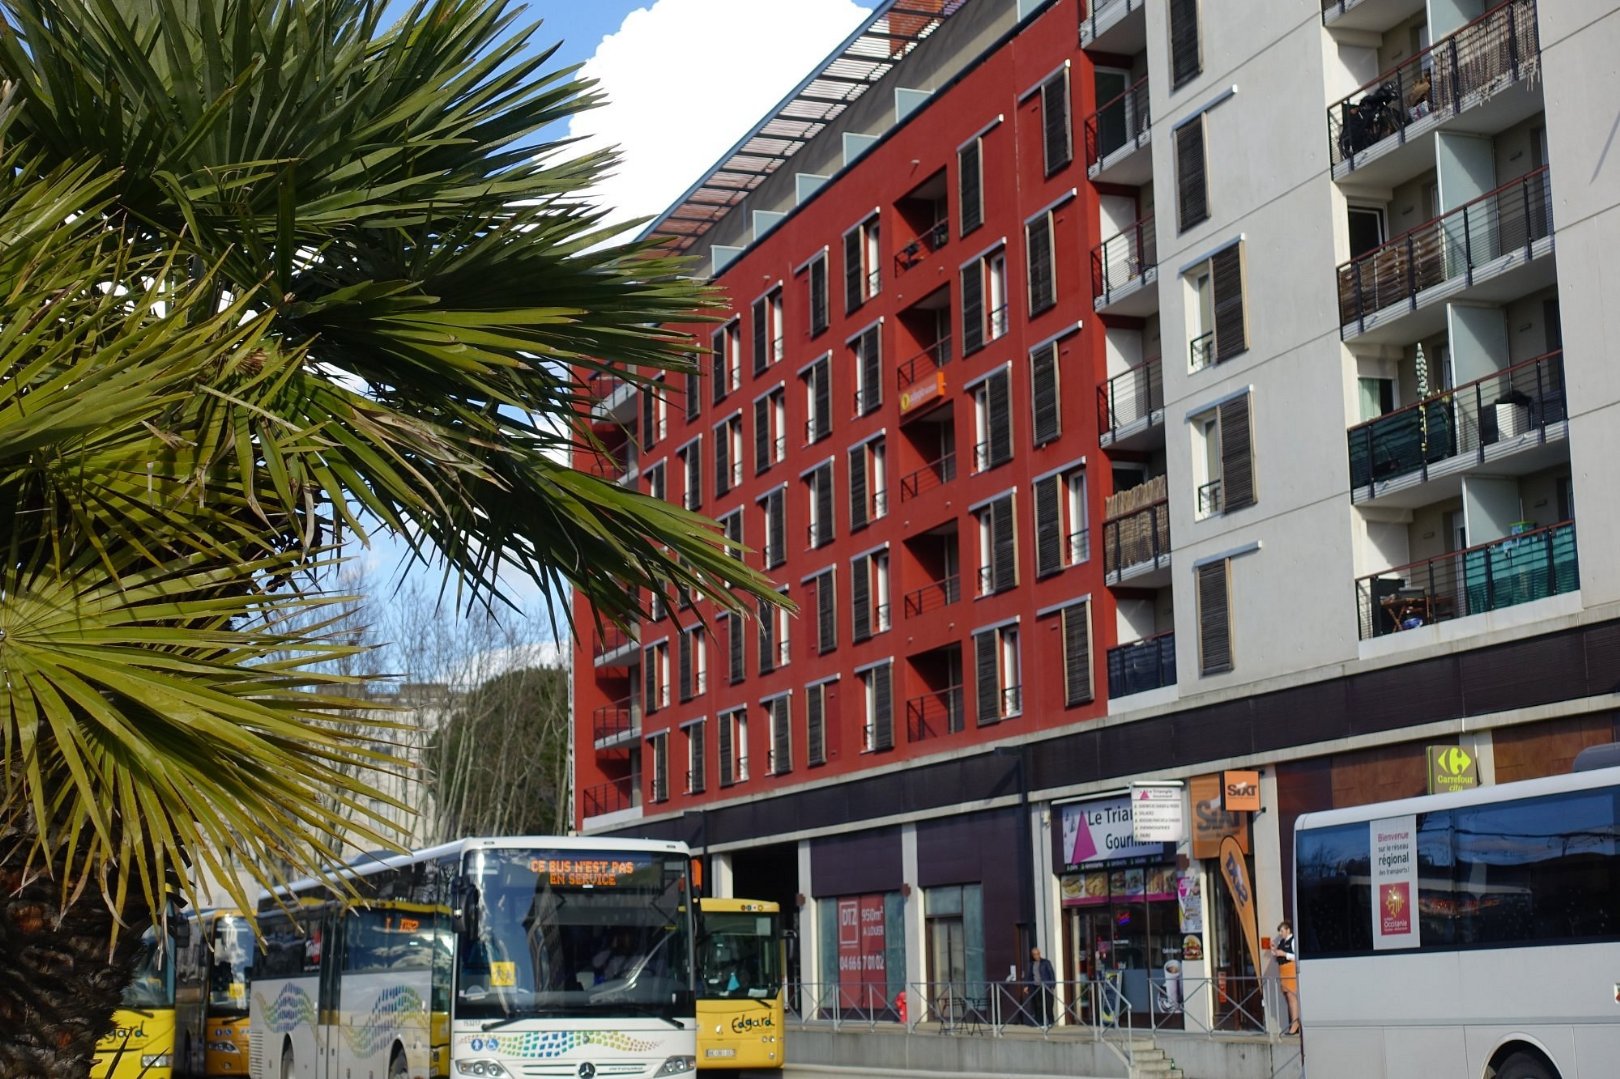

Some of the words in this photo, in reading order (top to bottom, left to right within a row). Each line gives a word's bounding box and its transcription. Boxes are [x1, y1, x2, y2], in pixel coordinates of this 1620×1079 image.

[1438, 774, 1473, 784] Carrefour
[1088, 810, 1102, 826] Le
[1104, 805, 1134, 824] Tria
[1377, 832, 1409, 843] Bienvenue
[1391, 843, 1409, 851] réseau
[1378, 851, 1409, 867] régional
[530, 859, 546, 873] CE
[549, 860, 571, 873] BUS
[575, 861, 609, 874] N'EST
[611, 861, 634, 874] PAS
[550, 873, 565, 885] EN
[568, 873, 617, 886] SERVICE
[842, 908, 858, 926] DTZ
[868, 925, 884, 936] LOUER
[731, 1012, 776, 1034] Edgard
